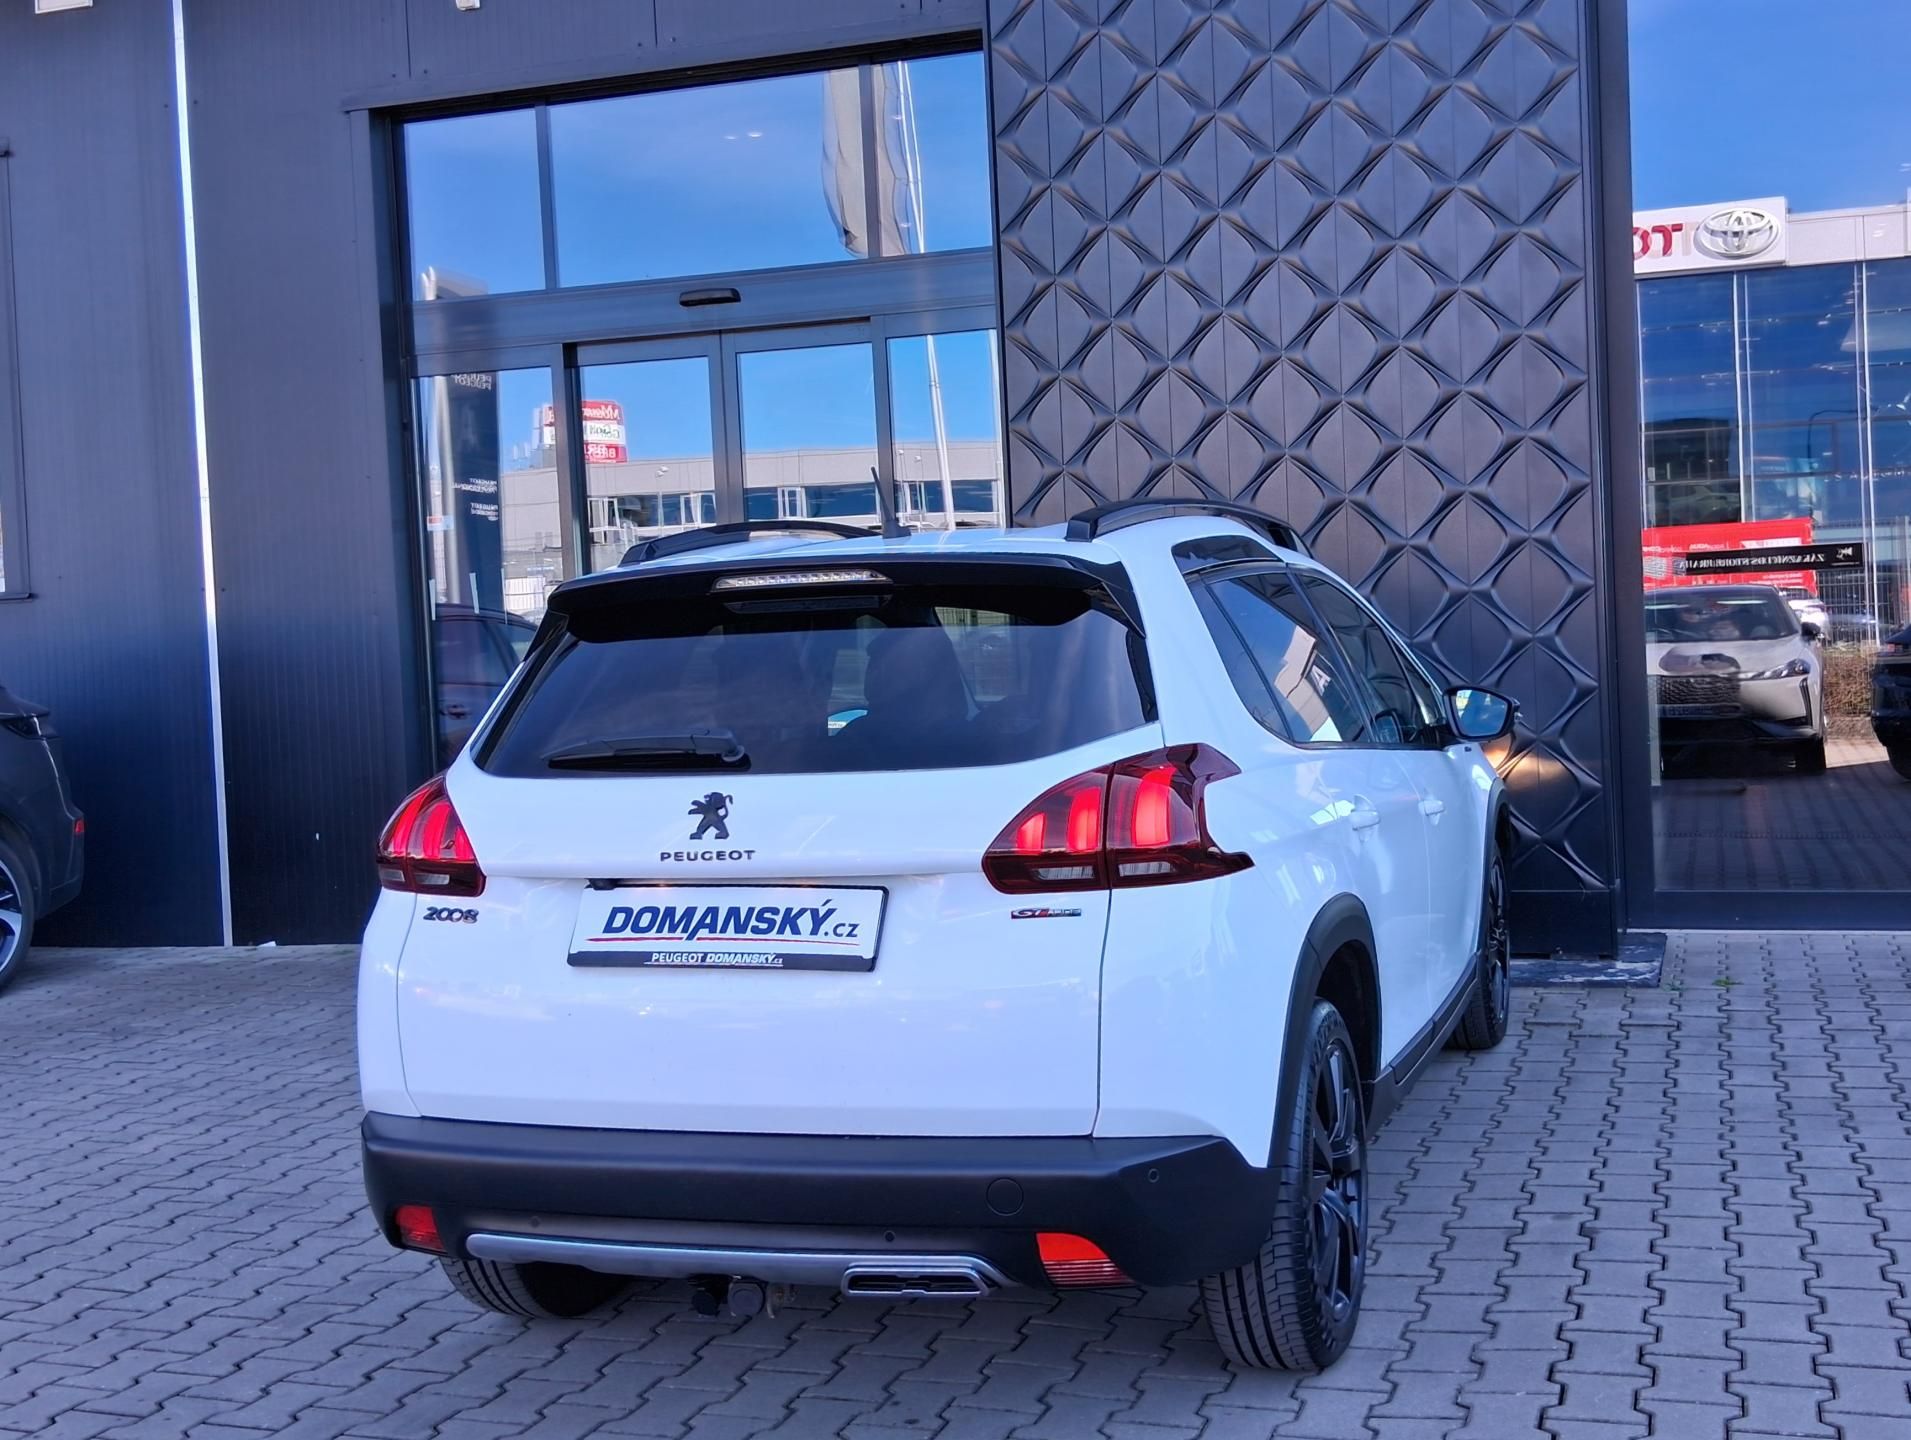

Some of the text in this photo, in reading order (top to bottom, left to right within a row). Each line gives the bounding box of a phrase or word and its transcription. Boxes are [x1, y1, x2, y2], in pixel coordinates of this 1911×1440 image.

[660, 850, 756, 862] PEUGEOT
[423, 906, 479, 923] 2008
[651, 952, 705, 963] PEUGEOT
